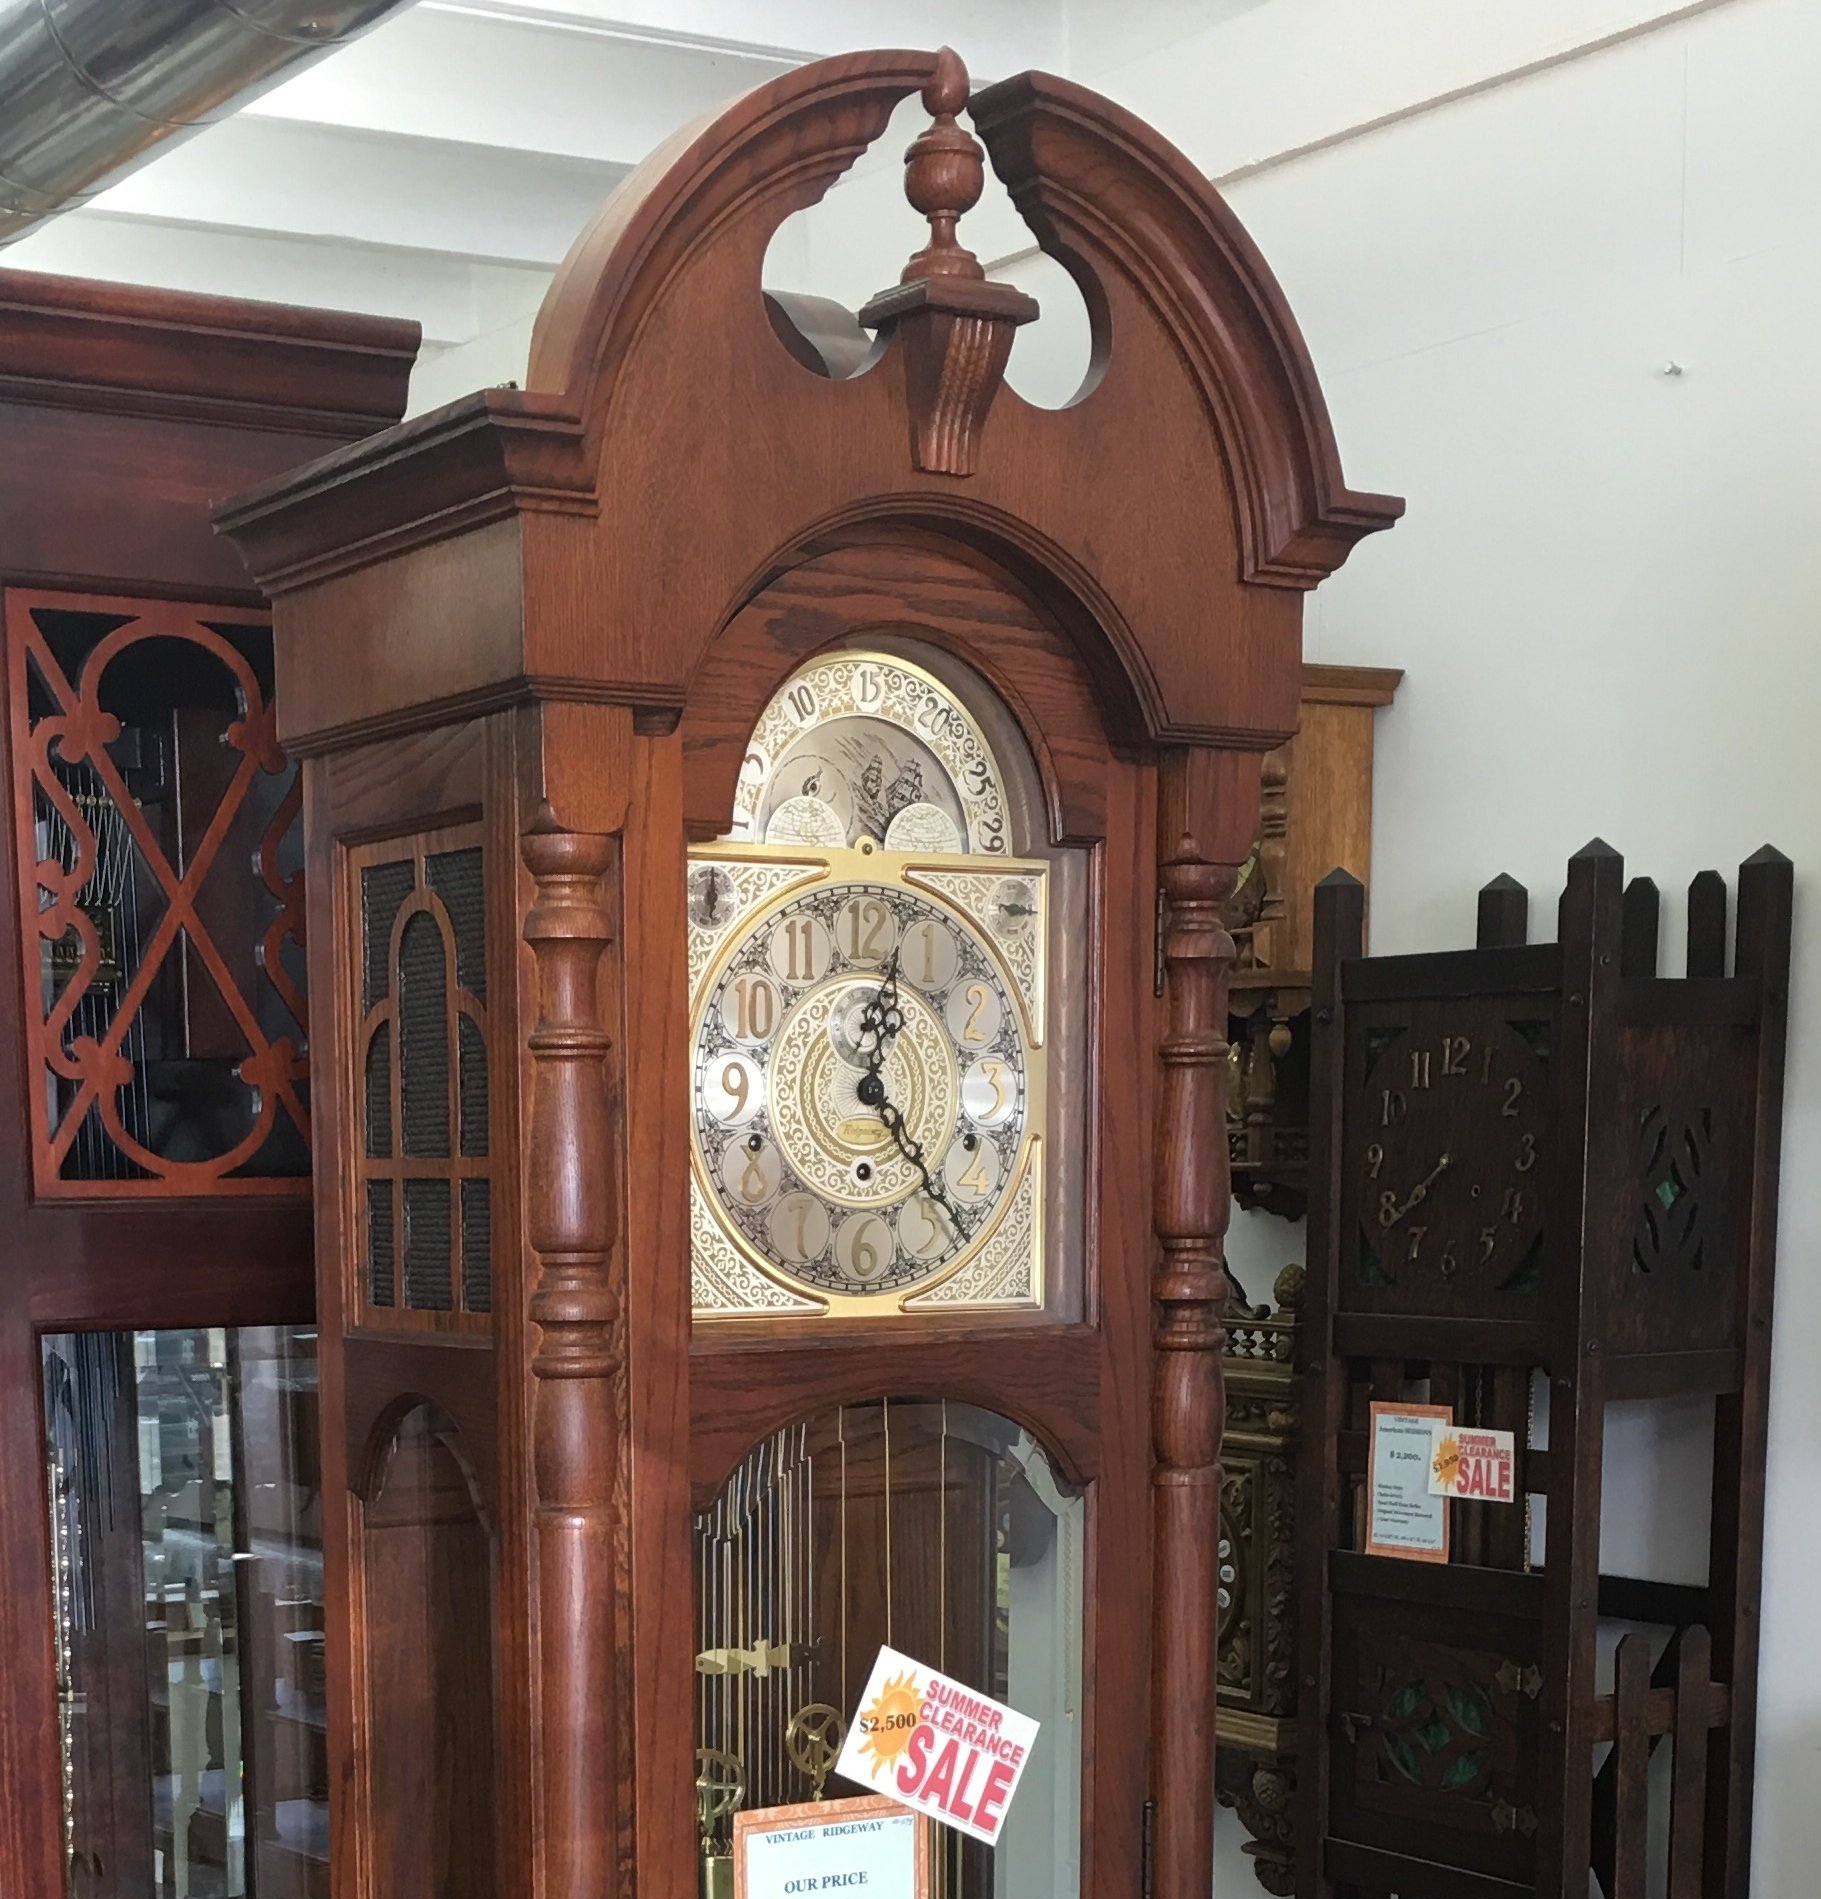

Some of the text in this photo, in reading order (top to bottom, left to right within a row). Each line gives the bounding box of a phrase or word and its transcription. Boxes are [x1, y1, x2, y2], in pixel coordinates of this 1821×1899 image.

[788, 685, 816, 722] 10
[860, 670, 881, 703] 15
[918, 697, 951, 736] 20
[963, 761, 995, 796] 25
[978, 819, 1004, 852] 29
[848, 900, 896, 960] 12
[785, 920, 815, 980] 11
[921, 923, 935, 983] 1
[735, 979, 773, 1039] 10
[965, 983, 988, 1041] 2
[1411, 1051, 1430, 1089] 11
[1441, 1036, 1471, 1076] 12
[1481, 1046, 1493, 1084] 1
[722, 1062, 749, 1120] 9
[978, 1062, 1005, 1120] 3
[1381, 1089, 1407, 1126] 10
[1502, 1078, 1522, 1117] 2
[957, 1138, 991, 1196] 4
[1368, 1144, 1383, 1178] 9
[1514, 1134, 1536, 1171] 3
[740, 1143, 768, 1202] 8
[1379, 1191, 1397, 1227] 8
[1502, 1187, 1523, 1224] 4
[788, 1199, 813, 1260] 7
[916, 1197, 943, 1254] 5
[1408, 1226, 1427, 1260] 7
[1480, 1225, 1497, 1264] 5
[852, 1218, 877, 1276] 6
[1458, 1445, 1511, 1460] CLEARANCE
[1459, 1433, 1496, 1447] SUMMER
[1457, 1456, 1511, 1498] SALE
[859, 1712, 917, 1733] $2,500
[926, 1680, 1003, 1730] SUMMER
[919, 1701, 1025, 1765] CLEARANCE
[897, 1724, 1016, 1833] SALE
[765, 1830, 815, 1844] VINTAGE
[822, 1821, 884, 1837] RIDGEWAY
[784, 1871, 868, 1894] OUR PRICE
